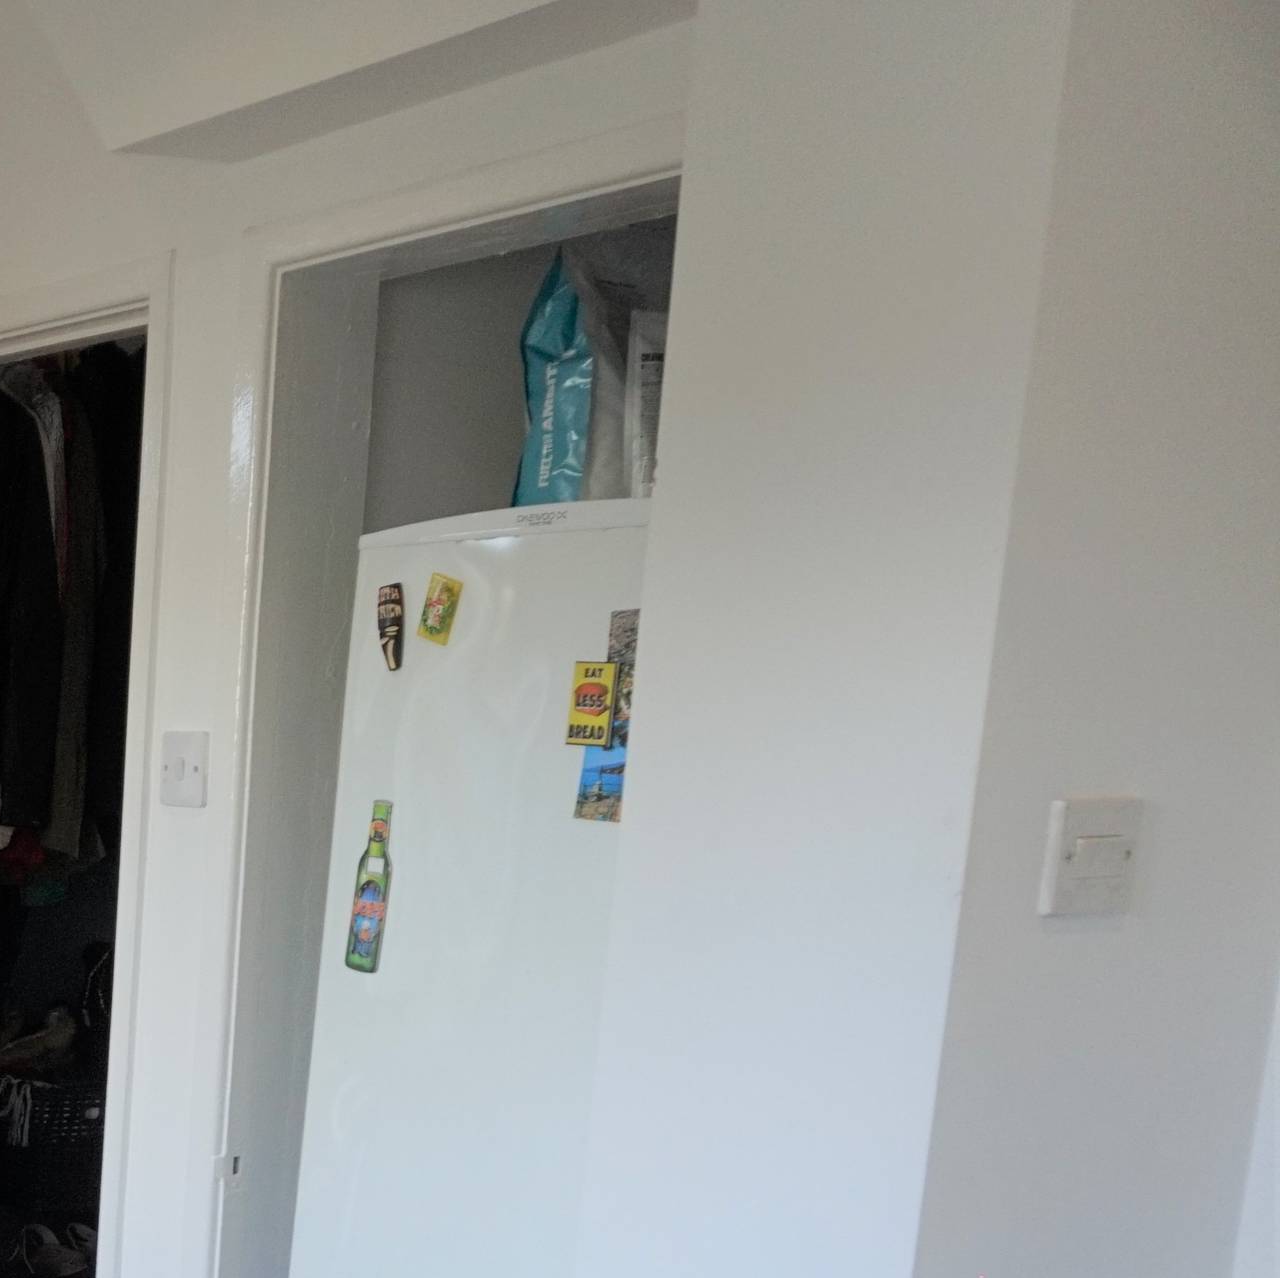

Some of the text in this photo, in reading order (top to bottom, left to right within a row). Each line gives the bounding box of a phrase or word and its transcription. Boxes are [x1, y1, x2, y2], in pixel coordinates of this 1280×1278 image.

[584, 668, 604, 678] EAT
[576, 694, 604, 707] LESS
[568, 725, 605, 739] BREAD
